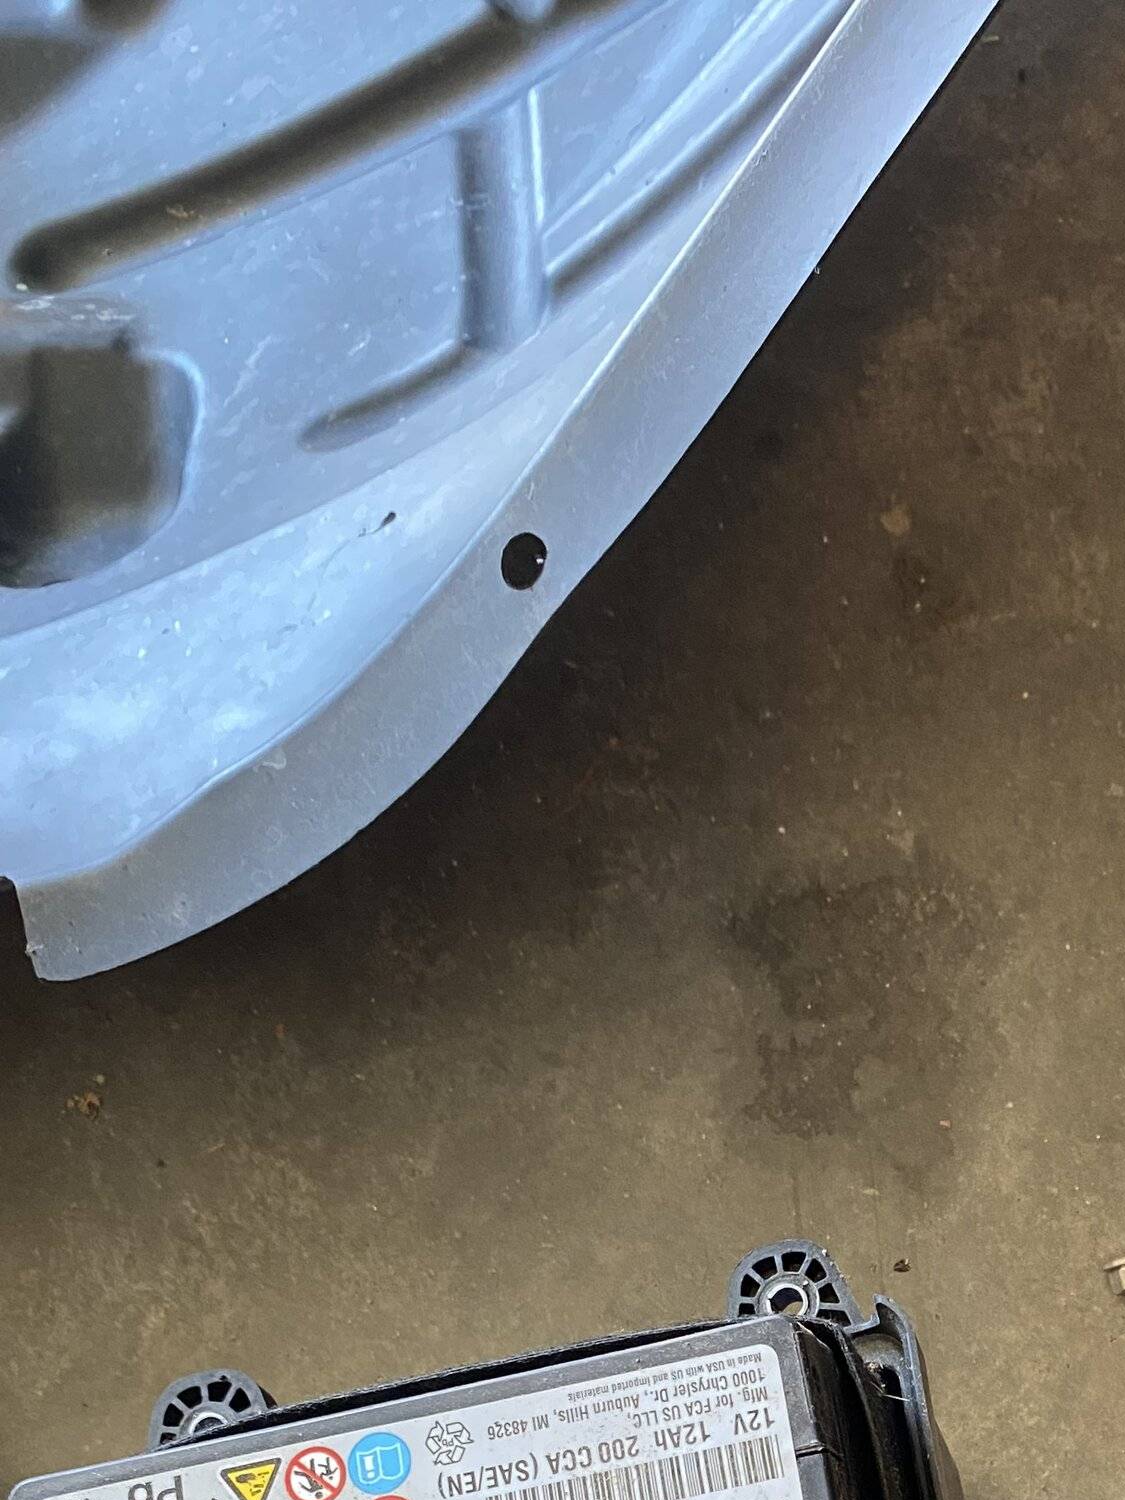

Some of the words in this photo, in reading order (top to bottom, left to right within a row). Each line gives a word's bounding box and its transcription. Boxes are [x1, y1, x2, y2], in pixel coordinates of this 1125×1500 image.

[705, 1359, 725, 1373] USA
[726, 1357, 736, 1369] in
[736, 1351, 762, 1367] Made
[652, 1372, 669, 1385] and
[670, 1368, 683, 1381] US
[685, 1364, 705, 1378] with
[731, 1366, 765, 1386] 1000
[567, 1384, 609, 1403] materials
[610, 1373, 651, 1394] imported
[670, 1371, 729, 1400] Chrysler
[643, 1385, 670, 1405] Dr.,
[713, 1392, 734, 1411] for
[736, 1382, 768, 1406] Mfg.
[551, 1402, 589, 1425] Hills,
[592, 1393, 641, 1417] Auburn
[660, 1404, 681, 1421] US
[683, 1397, 711, 1417] FCA
[531, 1413, 549, 1430] MI
[625, 1406, 659, 1429] LLC,
[730, 1405, 775, 1435] 12V
[485, 1416, 529, 1440] 48326
[652, 1419, 711, 1452] 12Ah
[440, 1436, 455, 1448] Pb
[596, 1434, 641, 1463] 200
[544, 1445, 593, 1475] CCA
[434, 1451, 540, 1499] (SAE/EN)
